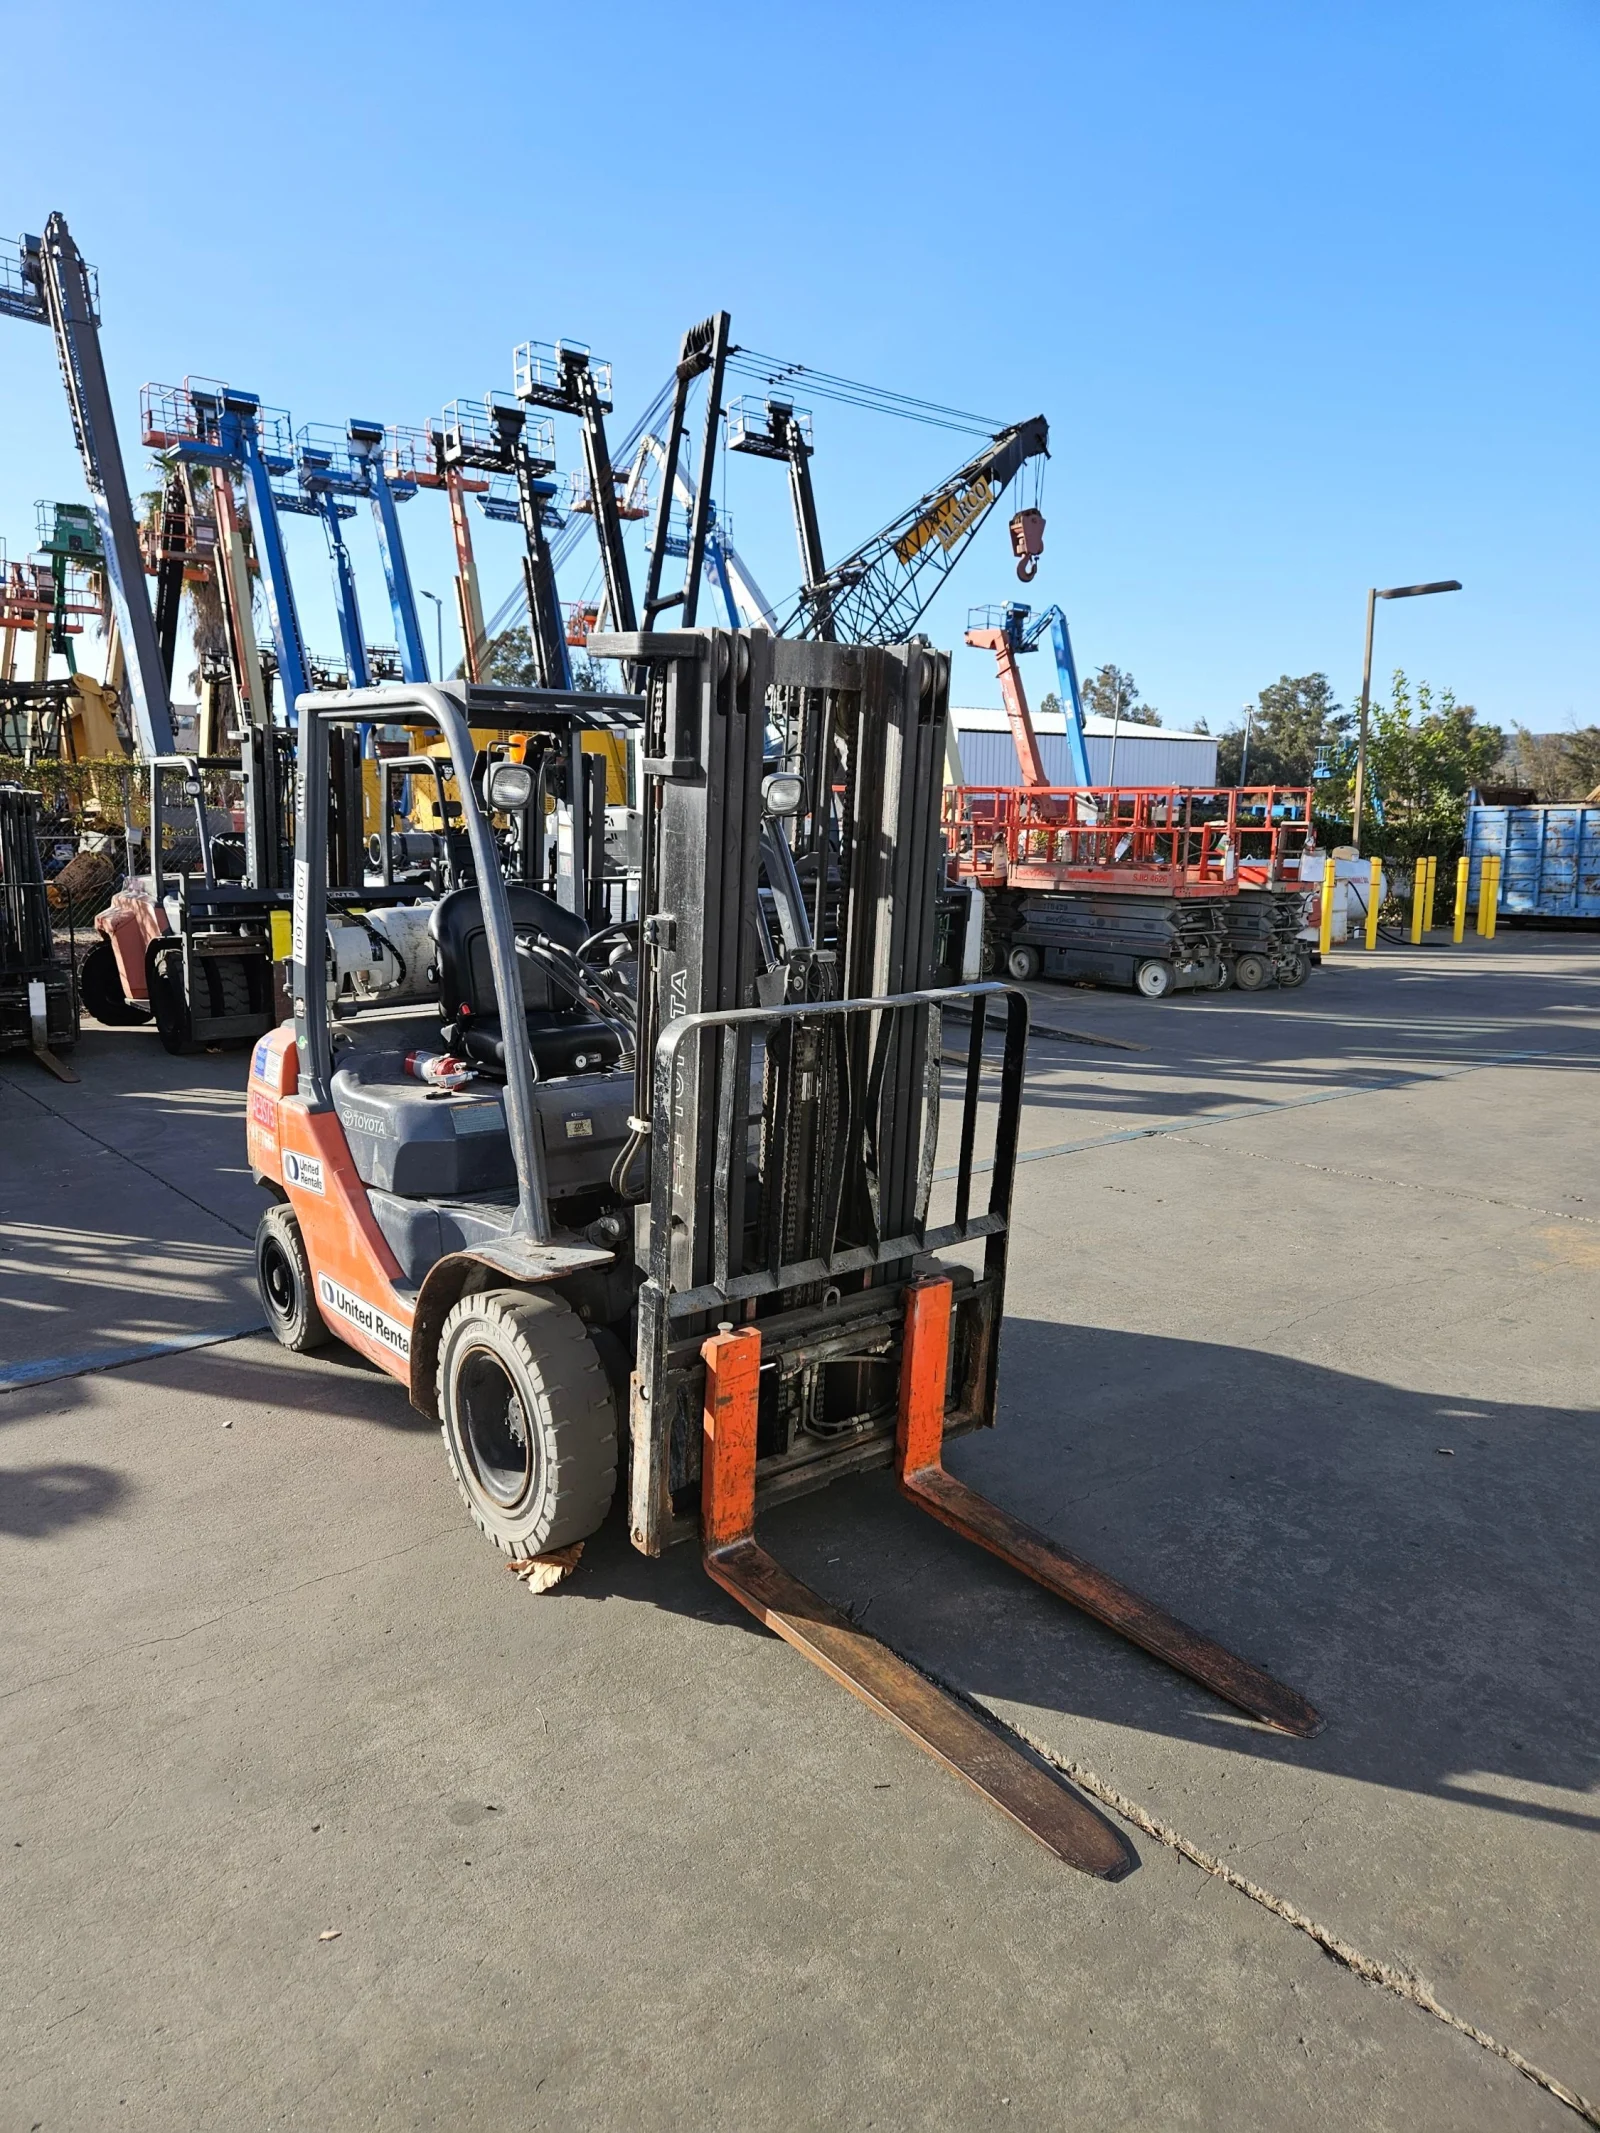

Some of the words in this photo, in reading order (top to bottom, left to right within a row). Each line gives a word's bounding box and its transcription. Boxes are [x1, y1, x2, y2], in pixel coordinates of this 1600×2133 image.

[939, 482, 986, 542] MARCO
[1018, 868, 1056, 878] SKYJACK
[295, 863, 305, 960] 10977667
[354, 1114, 385, 1135] TOYOTA
[300, 1158, 320, 1176] United
[301, 1173, 322, 1190] Rentals
[336, 1290, 373, 1330] United
[375, 1315, 409, 1354] Renta
